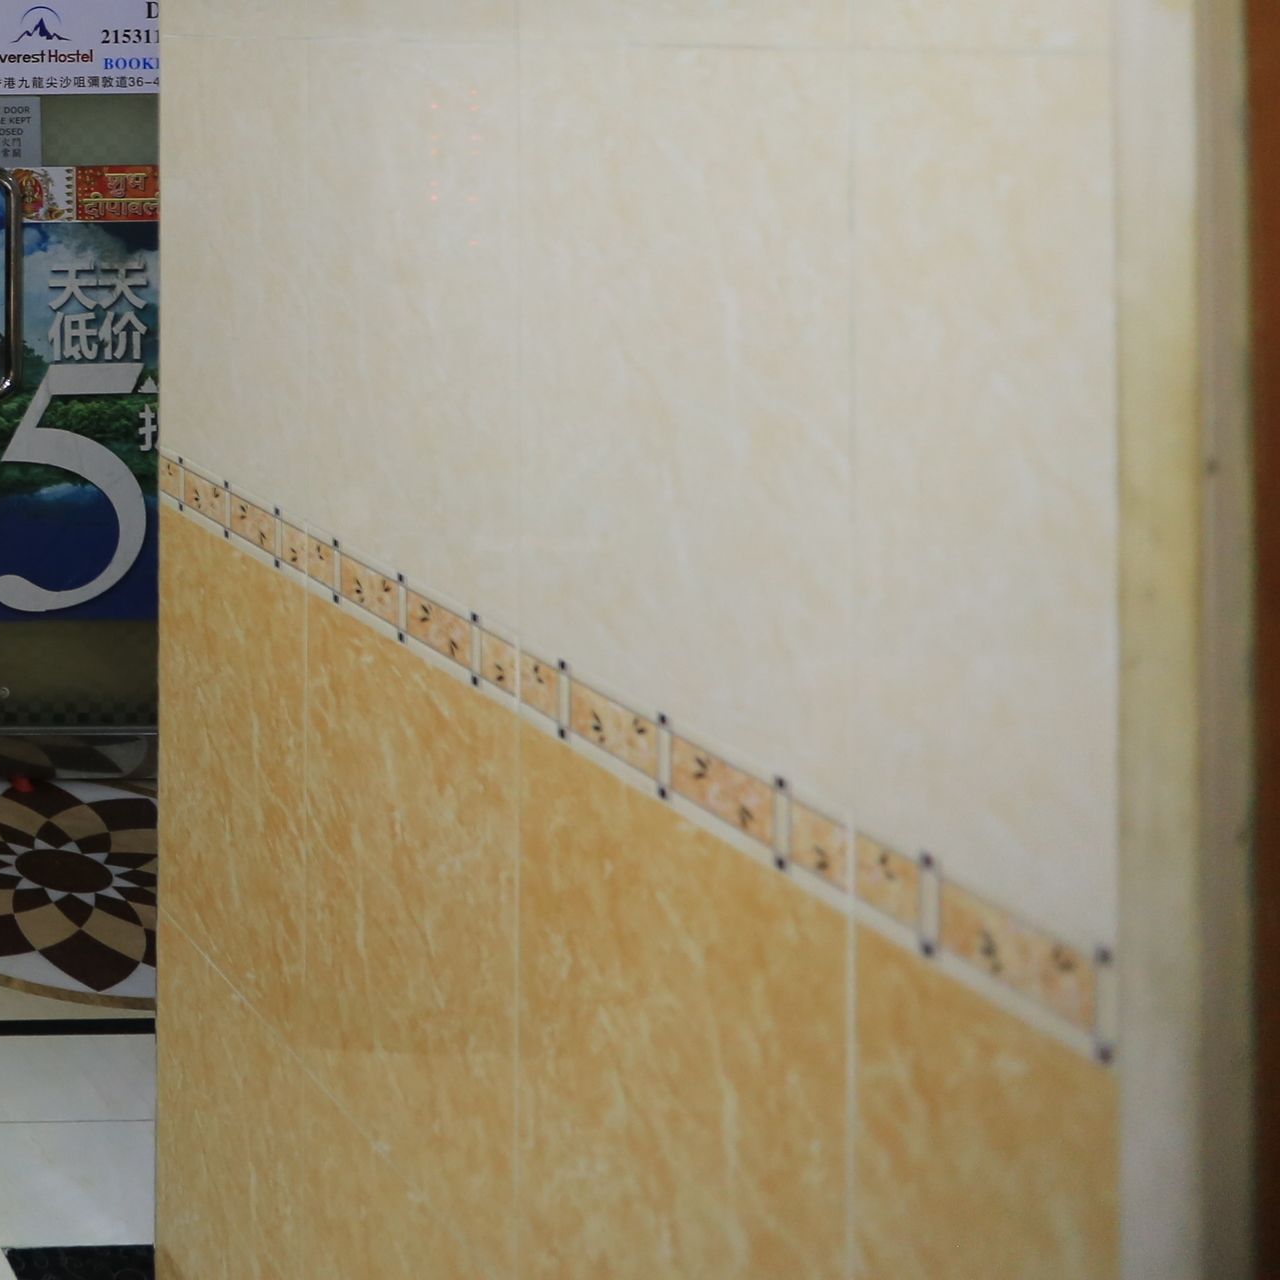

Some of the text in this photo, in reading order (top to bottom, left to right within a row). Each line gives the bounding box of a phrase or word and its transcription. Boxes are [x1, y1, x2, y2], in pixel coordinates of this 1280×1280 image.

[48, 49, 93, 62] Hostel
[4, 106, 30, 114] DOOR
[48, 260, 149, 311] 天天
[48, 310, 149, 362] 低价
